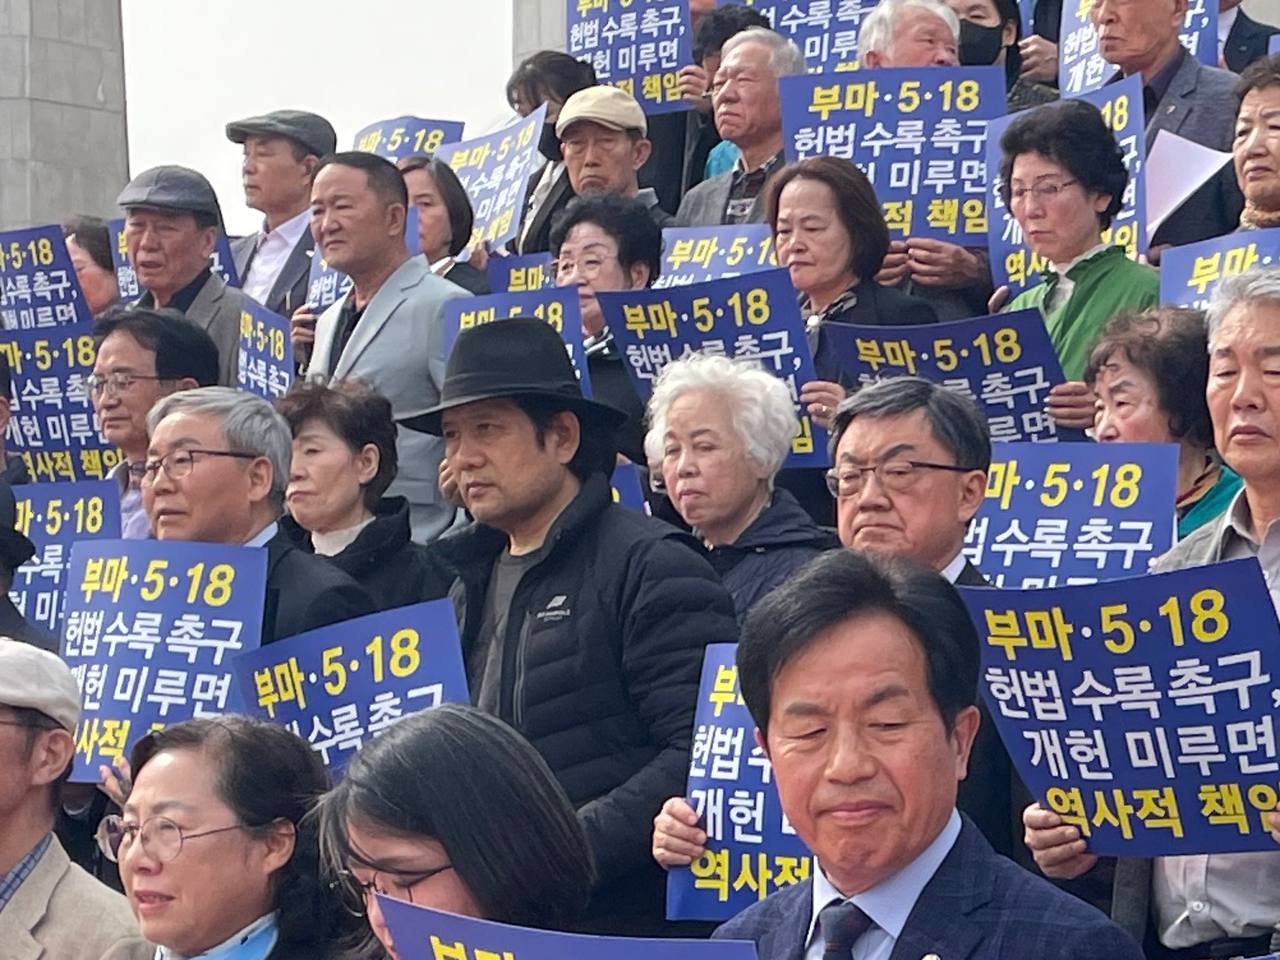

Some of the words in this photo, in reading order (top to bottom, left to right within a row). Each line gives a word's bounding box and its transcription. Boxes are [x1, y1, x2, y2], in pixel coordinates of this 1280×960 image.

[618, 38, 679, 74] 미루면
[808, 80, 979, 120] 부마·5·18
[861, 120, 926, 157] 수록
[927, 198, 988, 234] 책임
[0, 238, 54, 272] ·5·18
[622, 288, 770, 339] 부마·5·18
[856, 327, 1022, 375] 부마·5·18
[991, 518, 1068, 568] 수록
[80, 556, 235, 607] 부마·5·18
[65, 610, 104, 657] 헌법
[102, 611, 162, 660] 수록
[166, 613, 243, 666] 촉구
[984, 589, 1229, 661] 부마·5·18
[113, 666, 231, 719] 미루면
[254, 629, 420, 718] 부마·5·18
[985, 667, 1068, 721] 헌법
[1072, 665, 1161, 721] 수록
[73, 718, 131, 767] 사적
[308, 703, 364, 765] 수록
[690, 725, 744, 780] 헌법
[1023, 728, 1114, 781] 개헌
[1125, 715, 1280, 779] 미루면
[691, 788, 765, 843] 개헌
[1046, 786, 1184, 839] 역사적
